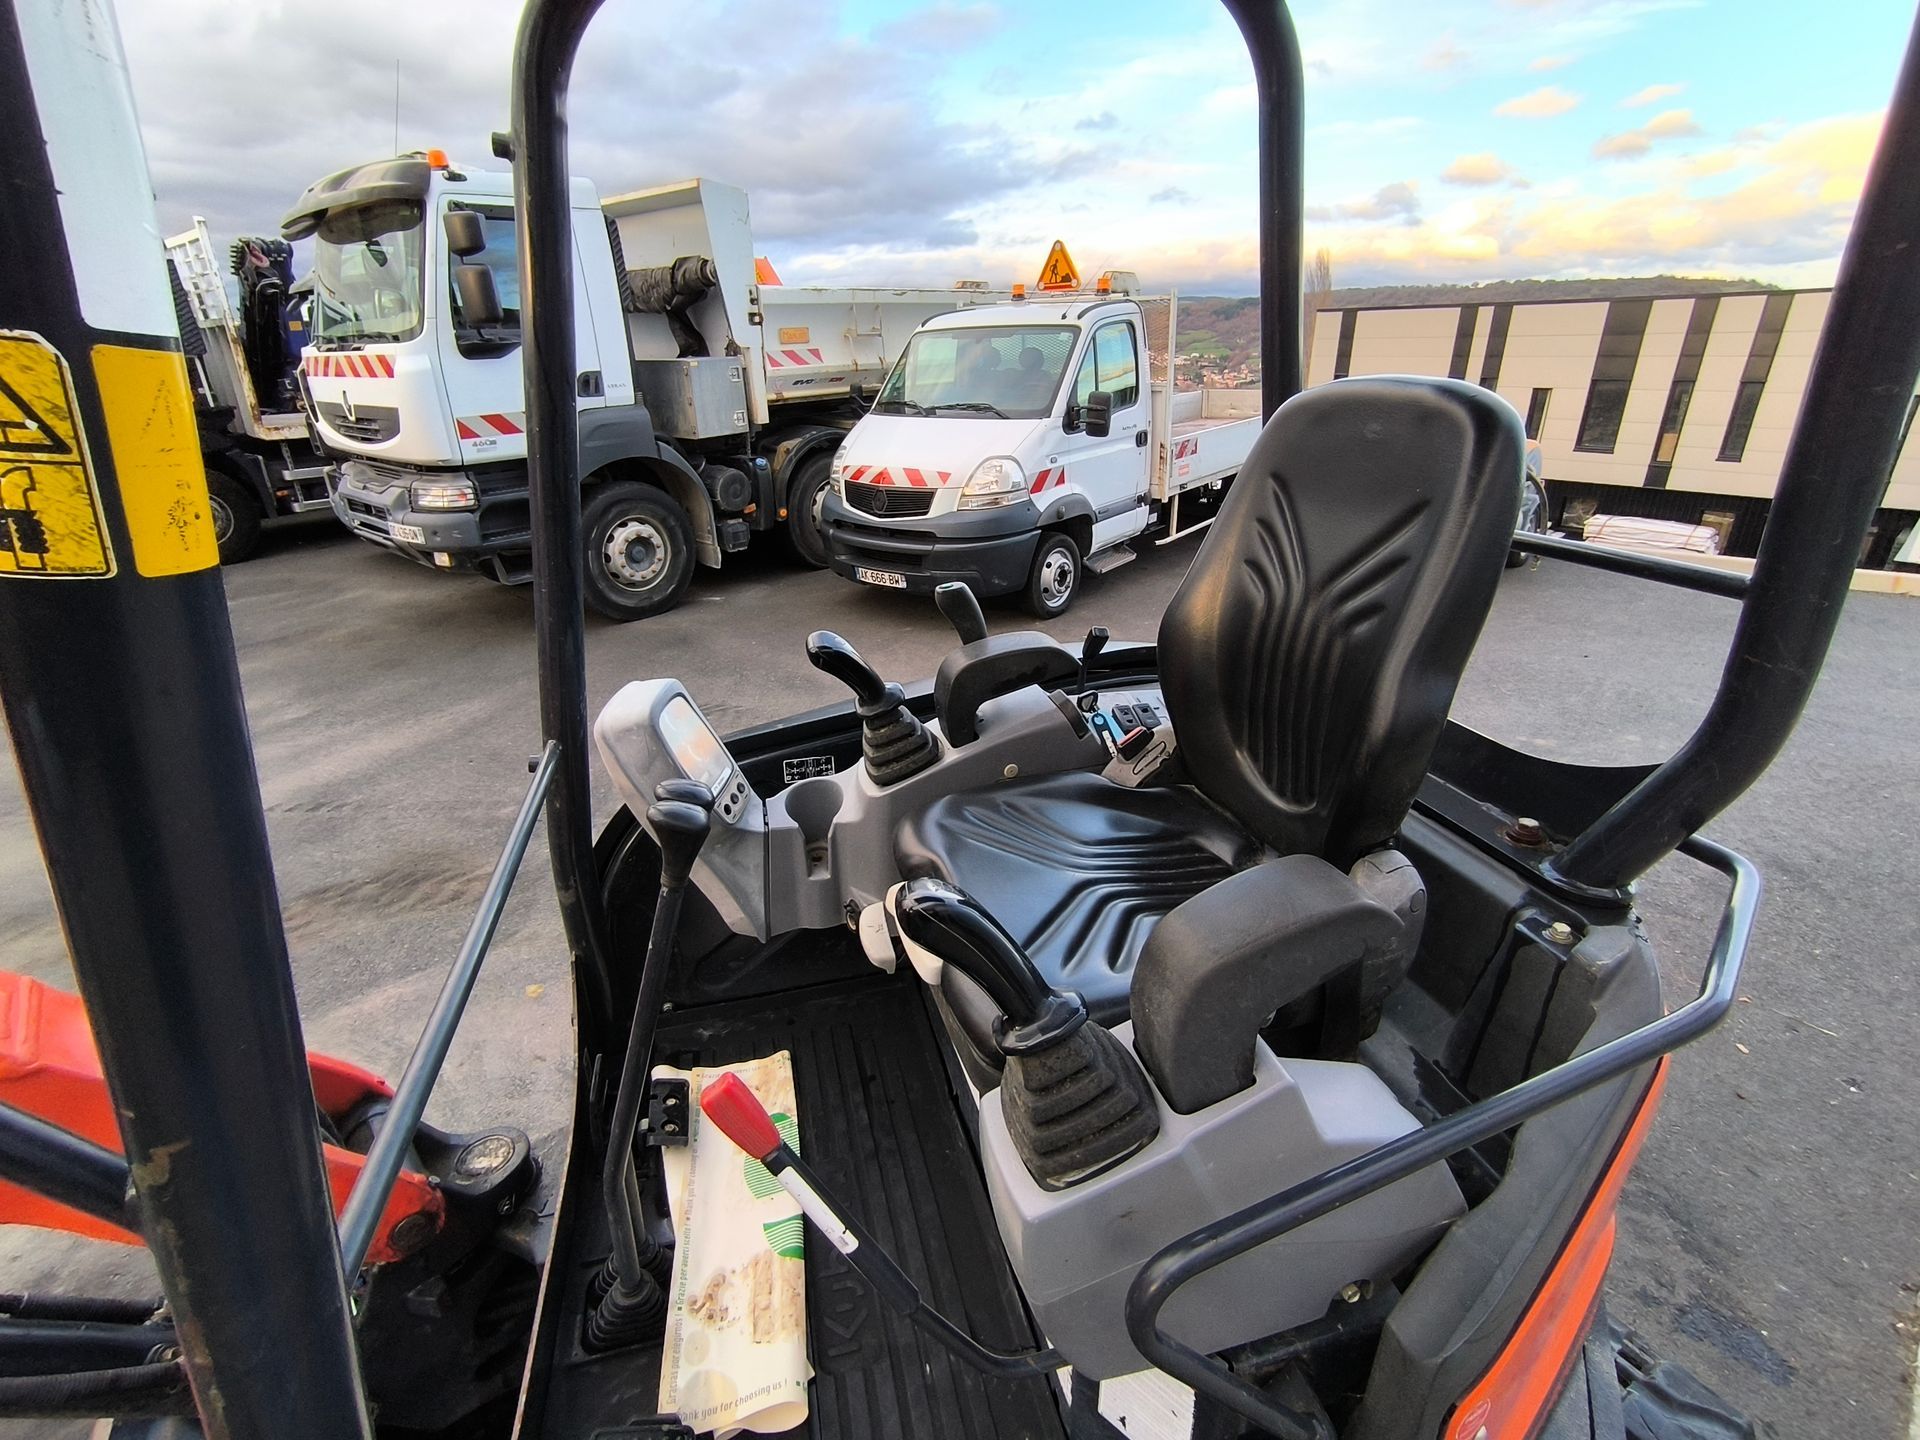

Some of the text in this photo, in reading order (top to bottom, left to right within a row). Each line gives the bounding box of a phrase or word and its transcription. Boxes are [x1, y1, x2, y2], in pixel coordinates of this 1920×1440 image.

[679, 1268, 689, 1281] per
[675, 1281, 688, 1306] Grazie
[671, 1355, 681, 1370] por
[666, 1369, 679, 1405] Gracias
[701, 1406, 719, 1420] you
[720, 1401, 734, 1413] for
[734, 1383, 771, 1408] choosing
[772, 1381, 782, 1391] us
